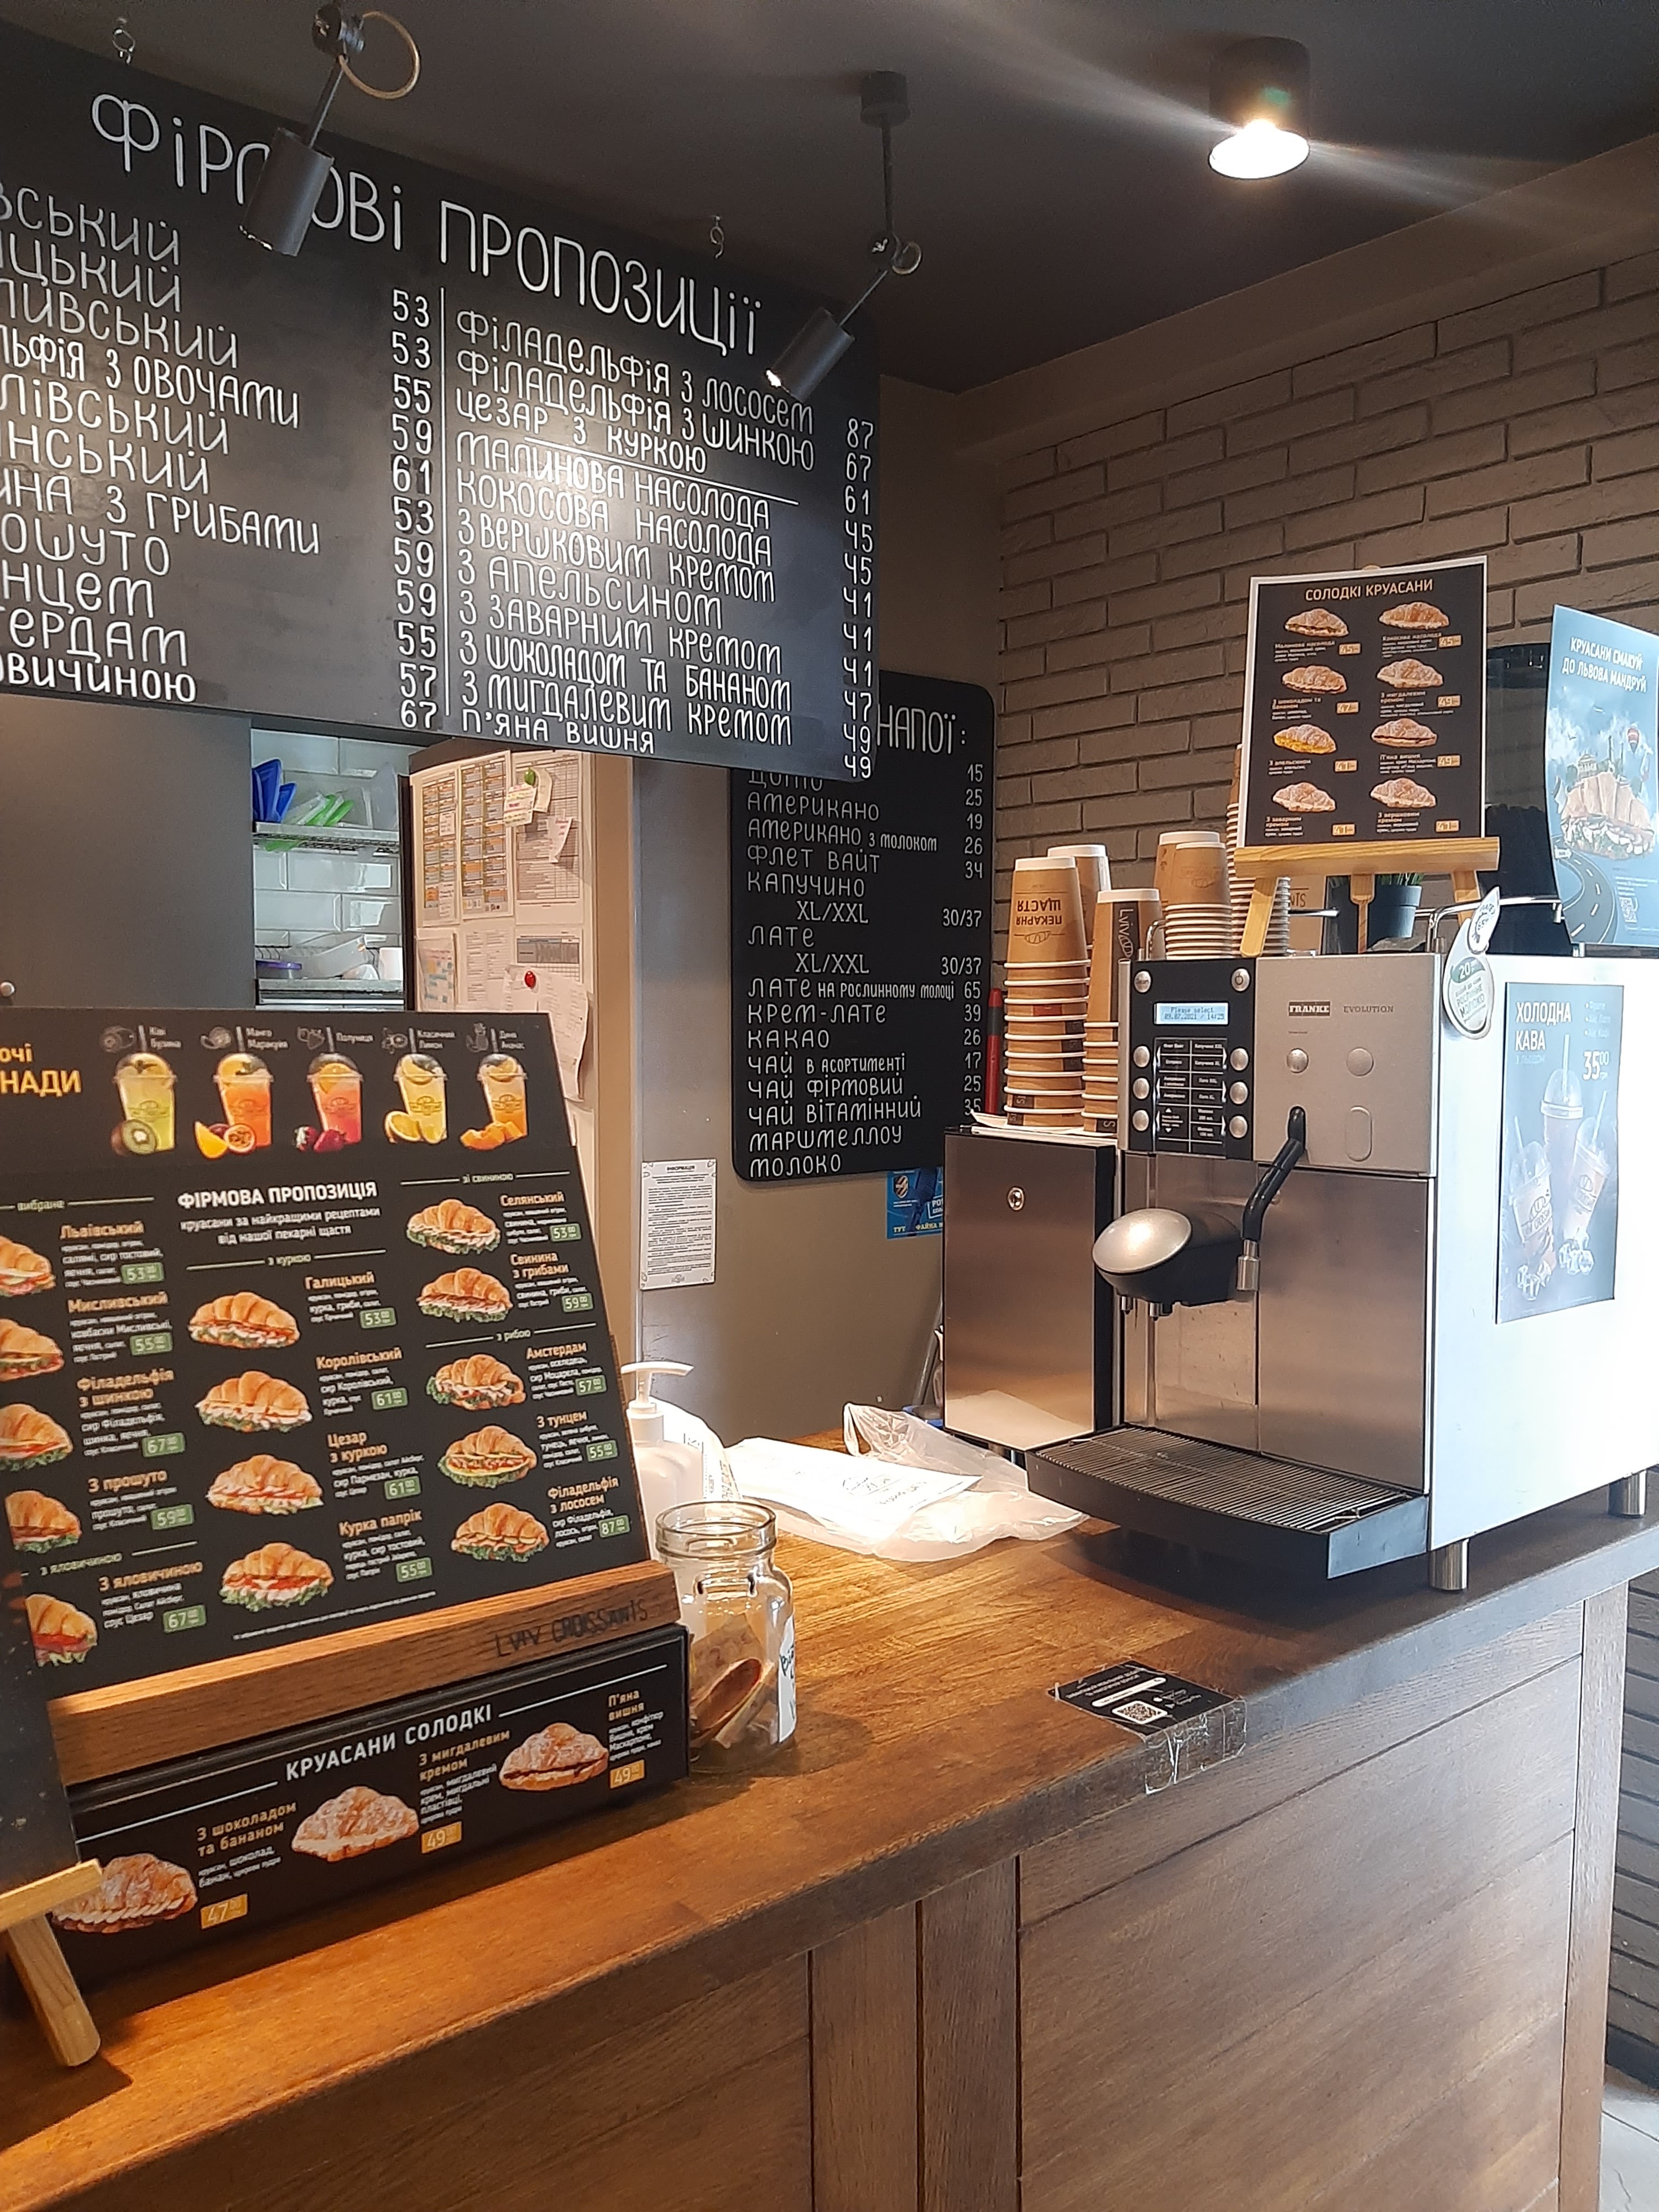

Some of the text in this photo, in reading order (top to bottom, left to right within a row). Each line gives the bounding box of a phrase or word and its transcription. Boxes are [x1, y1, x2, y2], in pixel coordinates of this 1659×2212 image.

[393, 290, 430, 328] 53
[393, 332, 431, 369] 53
[133, 356, 432, 455] ОВОЧАМИ 59
[393, 375, 431, 414] 55
[847, 418, 874, 449] 87
[703, 415, 815, 471] ШИНКОЮ
[846, 455, 872, 483] 67
[393, 455, 432, 495] 61
[607, 425, 707, 474] КУРКОЮ
[845, 488, 870, 517] 61
[457, 431, 874, 552] МАЛИНОВА НАСОЛОДА 45
[393, 497, 434, 535] 53
[457, 468, 872, 586] КОКОСОВА НАСОЛОДА 45
[146, 492, 435, 578] ГРИБАМИ 59
[395, 579, 436, 617] 59
[1305, 578, 1434, 602] СОЛОДКІ КРУАСАНИ
[843, 589, 873, 618] 41
[397, 621, 437, 659] 55
[490, 592, 653, 654] ЗАВАРНИМ
[843, 659, 873, 687] 41
[843, 624, 873, 653] 41
[1570, 637, 1611, 662] КРУАСАНИ
[399, 662, 437, 698] 57
[486, 633, 873, 722] ШОКОЛАДОМ ТА БАНАНОМ 47
[1562, 657, 1647, 692] ДО ЛЬВОВА МАНДРУЙ
[400, 700, 437, 728] 67
[567, 722, 655, 754] ВИШНЯ
[844, 755, 872, 779] 49
[843, 724, 872, 755] 49
[967, 763, 984, 782] 15
[965, 789, 983, 807] 25
[966, 813, 983, 831] 19
[828, 849, 880, 874] ВАЙТ
[964, 837, 983, 855] 26
[748, 862, 983, 898] КАПУЧИНО 34
[797, 900, 982, 928] XL/XXL 30/37
[795, 953, 982, 977] XL/XXL 30/37
[963, 981, 981, 1000] 65
[963, 1004, 981, 1022] 39
[1516, 1001, 1572, 1026] ХОЛОДНА
[748, 1029, 982, 1050] КАКАО 26
[748, 1051, 793, 1075] ЧАЙ
[964, 1052, 981, 1071] 17
[1515, 1030, 1600, 1080] КАВА 35
[748, 1074, 794, 1099] ЧАЙ
[963, 1075, 982, 1093] 25
[748, 1100, 794, 1127] ЧАЙ
[750, 1154, 841, 1178] МОЛОКО
[177, 1181, 378, 1209] ФІРМОВА ПРОПОЗИЦІЯ
[500, 1191, 565, 1207] Селянський
[553, 1227, 567, 1239] 53
[510, 1252, 559, 1266] Свинина
[305, 1270, 375, 1290] Галицький
[565, 1297, 580, 1310] 59
[364, 1312, 381, 1326] 53
[526, 1342, 587, 1360] Амстердам
[578, 1379, 593, 1392] 57
[376, 1393, 392, 1407] 61
[547, 1411, 587, 1427] тунцем
[147, 1439, 165, 1454] 67
[327, 1431, 367, 1448] Цезар
[589, 1446, 604, 1459] 55
[340, 1443, 388, 1463] куркою
[389, 1482, 405, 1496] 61
[157, 1511, 175, 1526] 59
[338, 1509, 422, 1538] Курка папрік
[601, 1521, 615, 1534] 87
[400, 1564, 417, 1578] 55
[168, 1614, 186, 1629] 67
[285, 1704, 492, 1781] КРУАСАНИ СОЛОДКІ
[419, 1757, 468, 1782] кремом
[212, 1802, 297, 1837] шоколадом
[197, 1822, 284, 1857] та бананом
